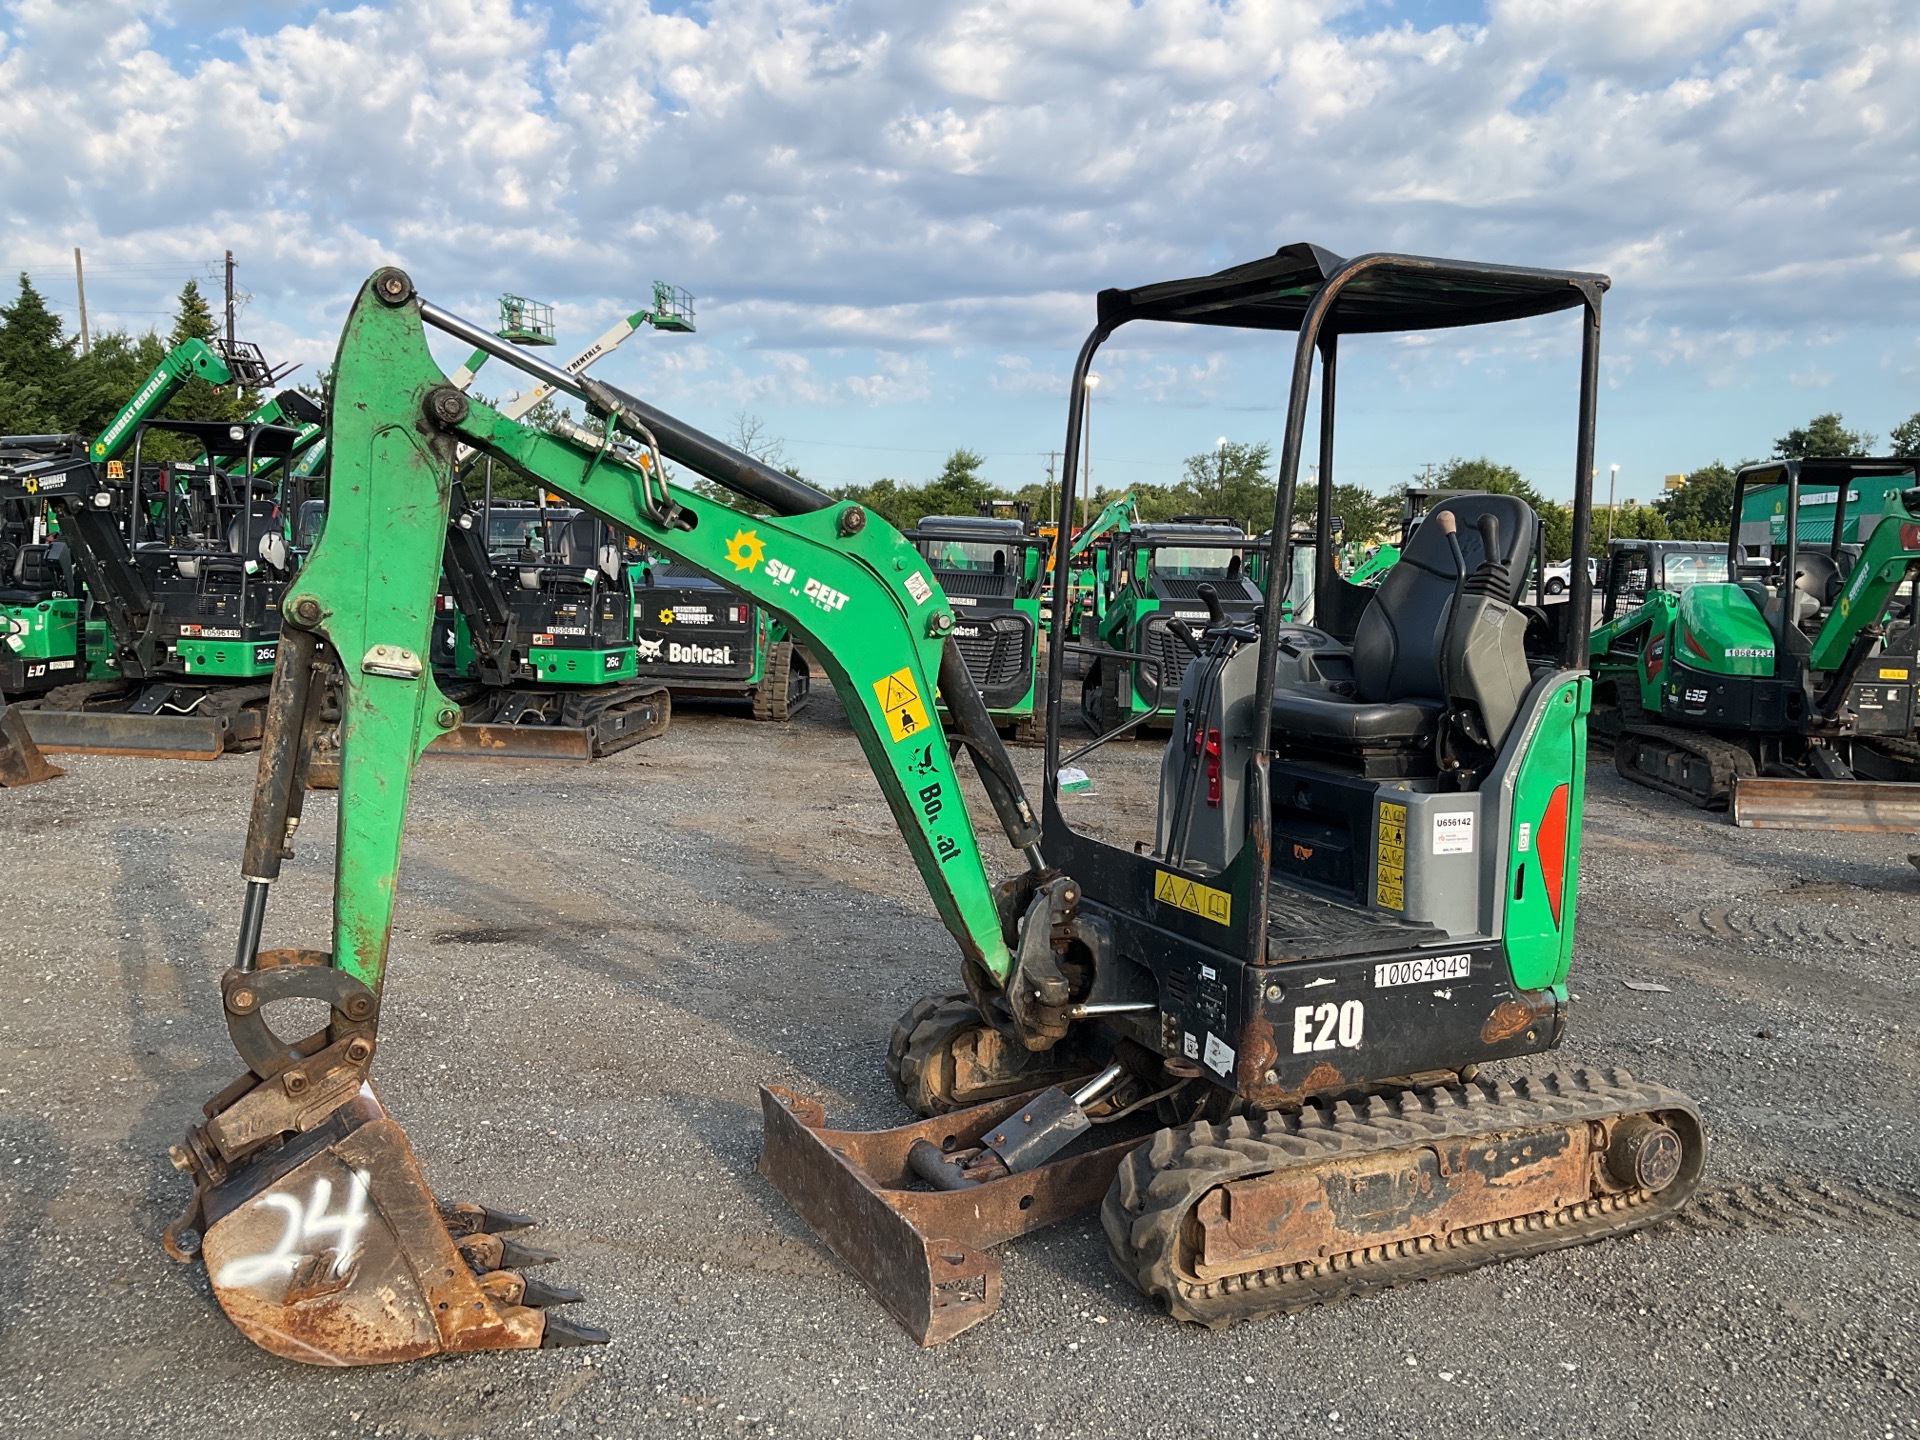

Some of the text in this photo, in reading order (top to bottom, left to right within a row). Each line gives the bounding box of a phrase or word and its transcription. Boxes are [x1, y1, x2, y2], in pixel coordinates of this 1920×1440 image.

[572, 344, 602, 370] RENTALS
[103, 370, 168, 446] SUNBELT RENTALS
[38, 473, 67, 487] SUNBELT
[764, 558, 851, 611] SUBELT
[675, 613, 714, 622] SUNBELT
[202, 629, 241, 638] 10596149
[547, 626, 586, 635] 10596147
[951, 626, 979, 637] obcat
[257, 649, 276, 660] 26G
[669, 642, 731, 665] Bobcat
[606, 657, 620, 668] 26G
[27, 664, 46, 678] E10
[918, 782, 962, 864] Boat
[1436, 817, 1471, 828] U656142
[1378, 956, 1470, 987] 10064949
[1292, 999, 1364, 1054] E20
[216, 1168, 371, 1288] 24
